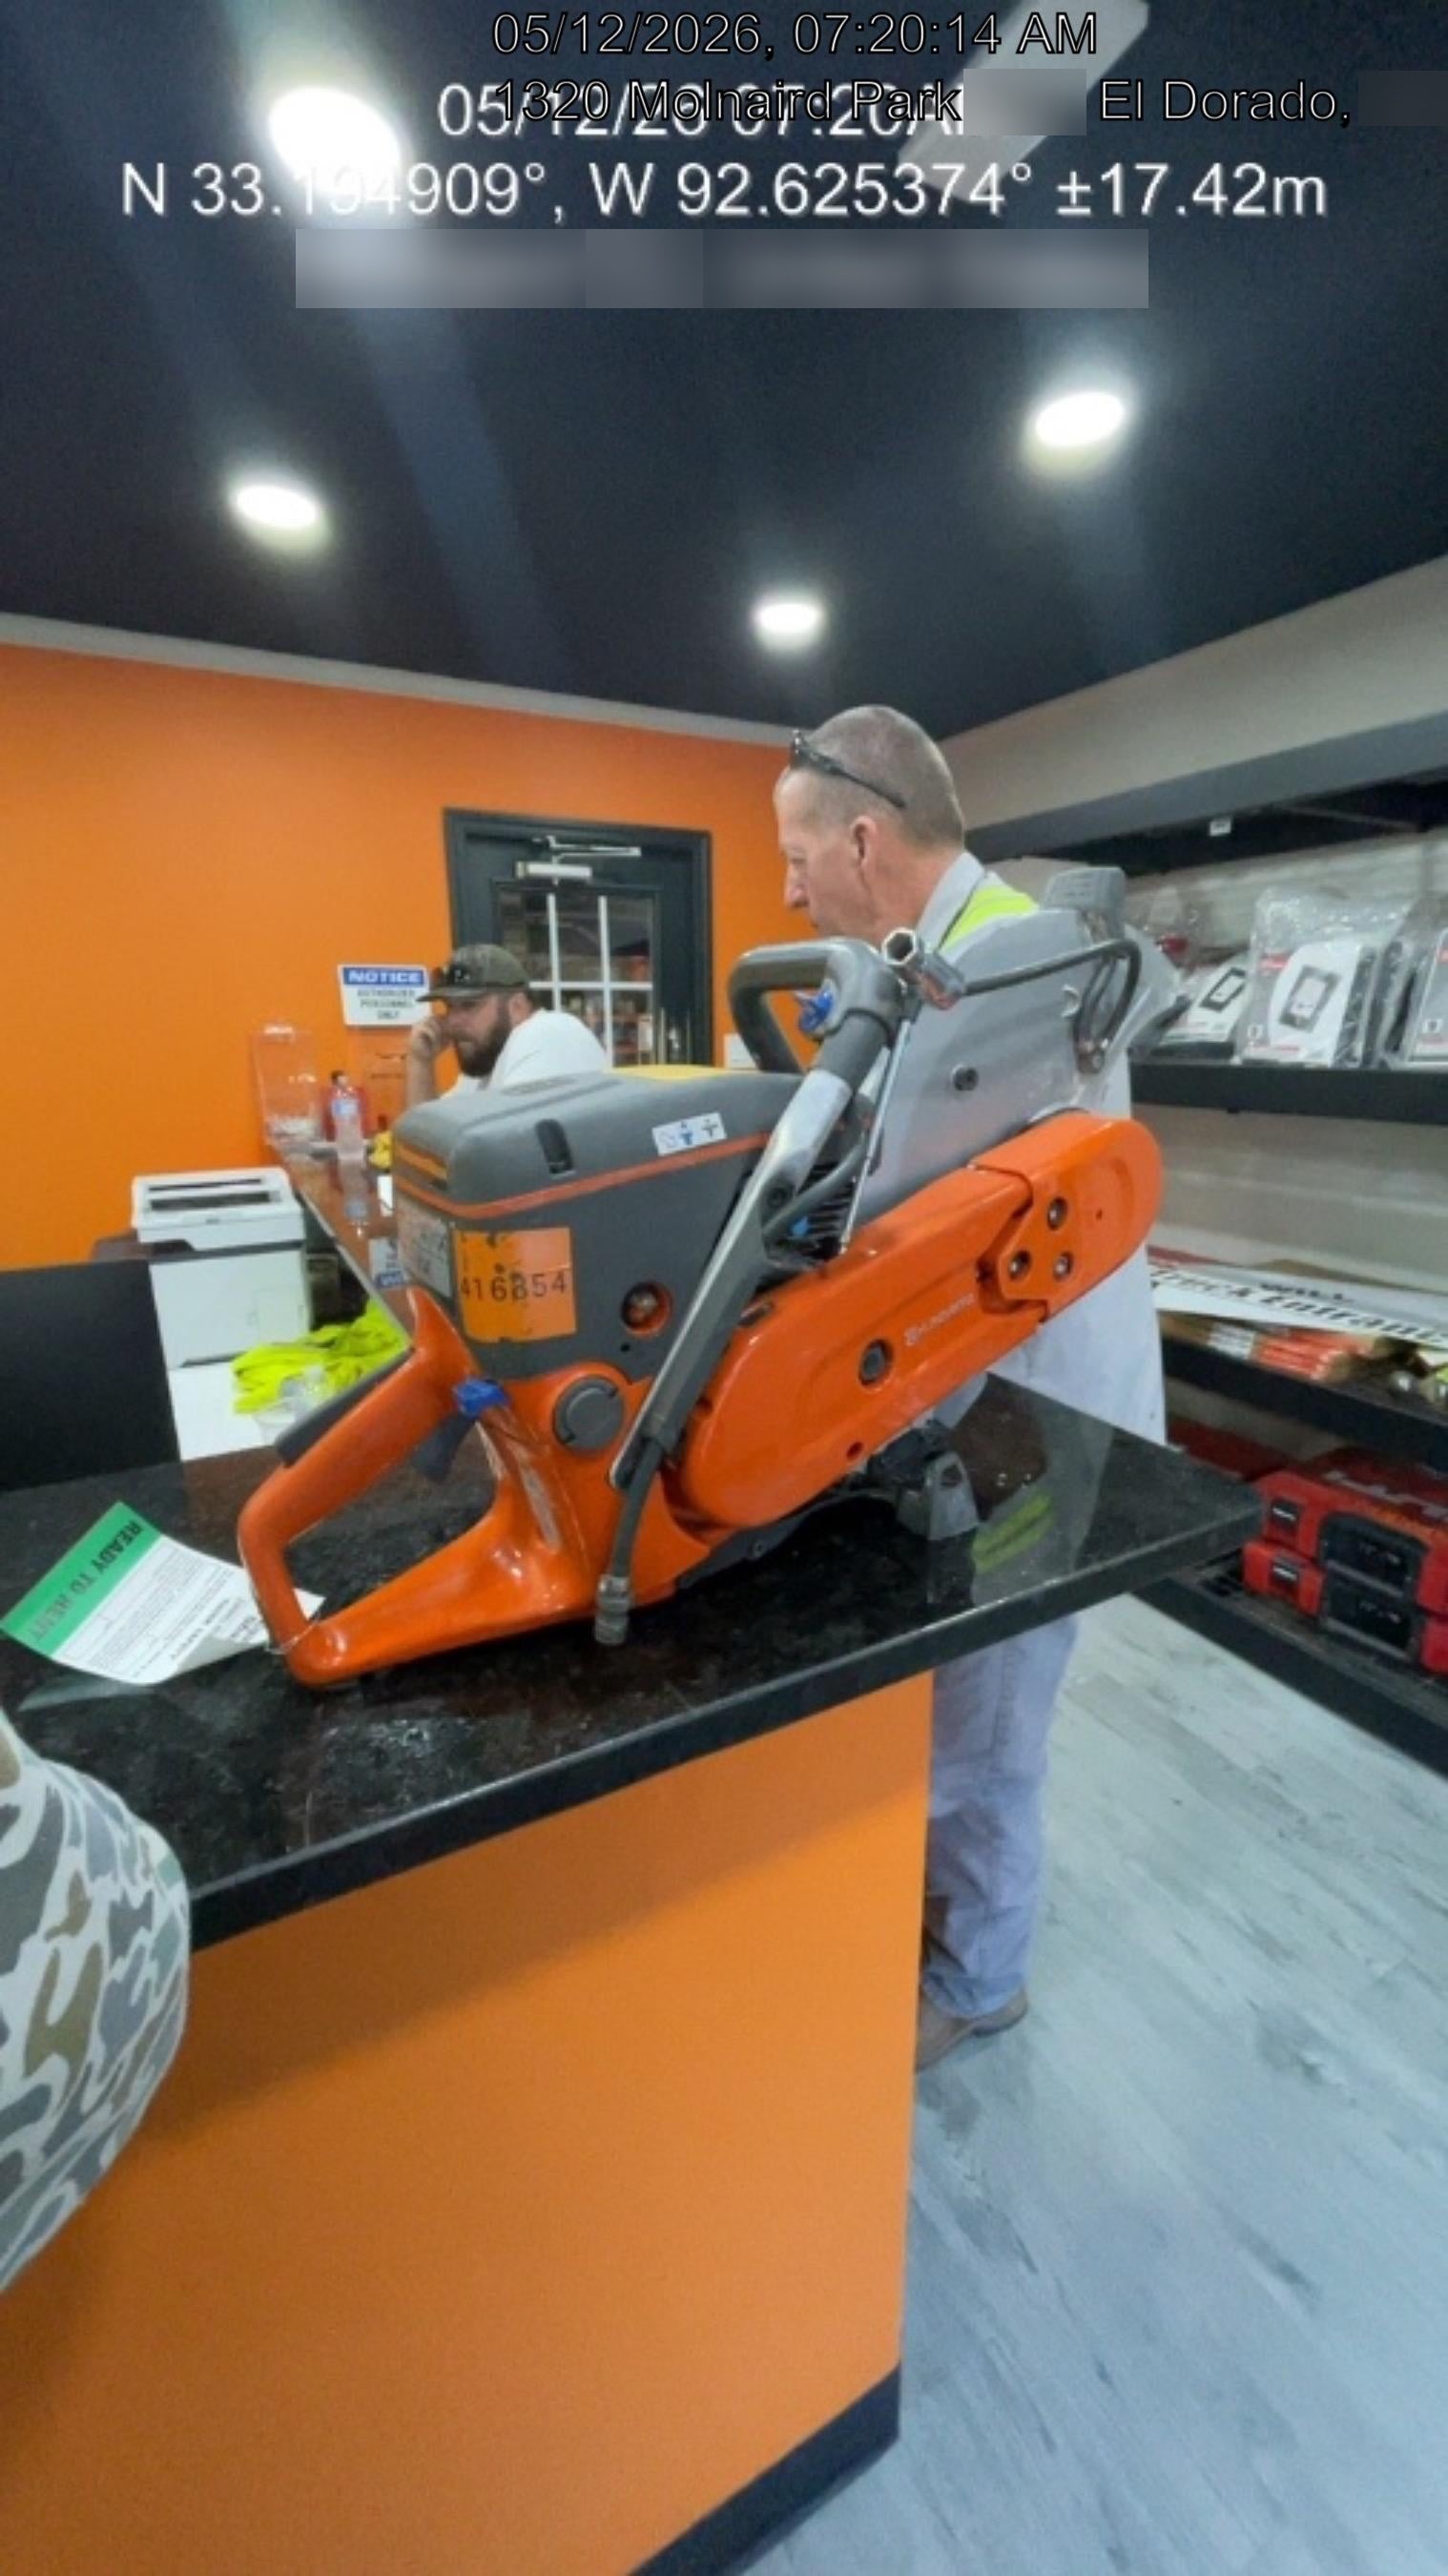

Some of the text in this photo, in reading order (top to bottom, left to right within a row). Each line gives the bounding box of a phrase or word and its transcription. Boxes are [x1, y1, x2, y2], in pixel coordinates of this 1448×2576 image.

[347, 969, 421, 984] NOTICE
[91, 1520, 143, 1575] READY
[70, 1572, 95, 1596] TO
